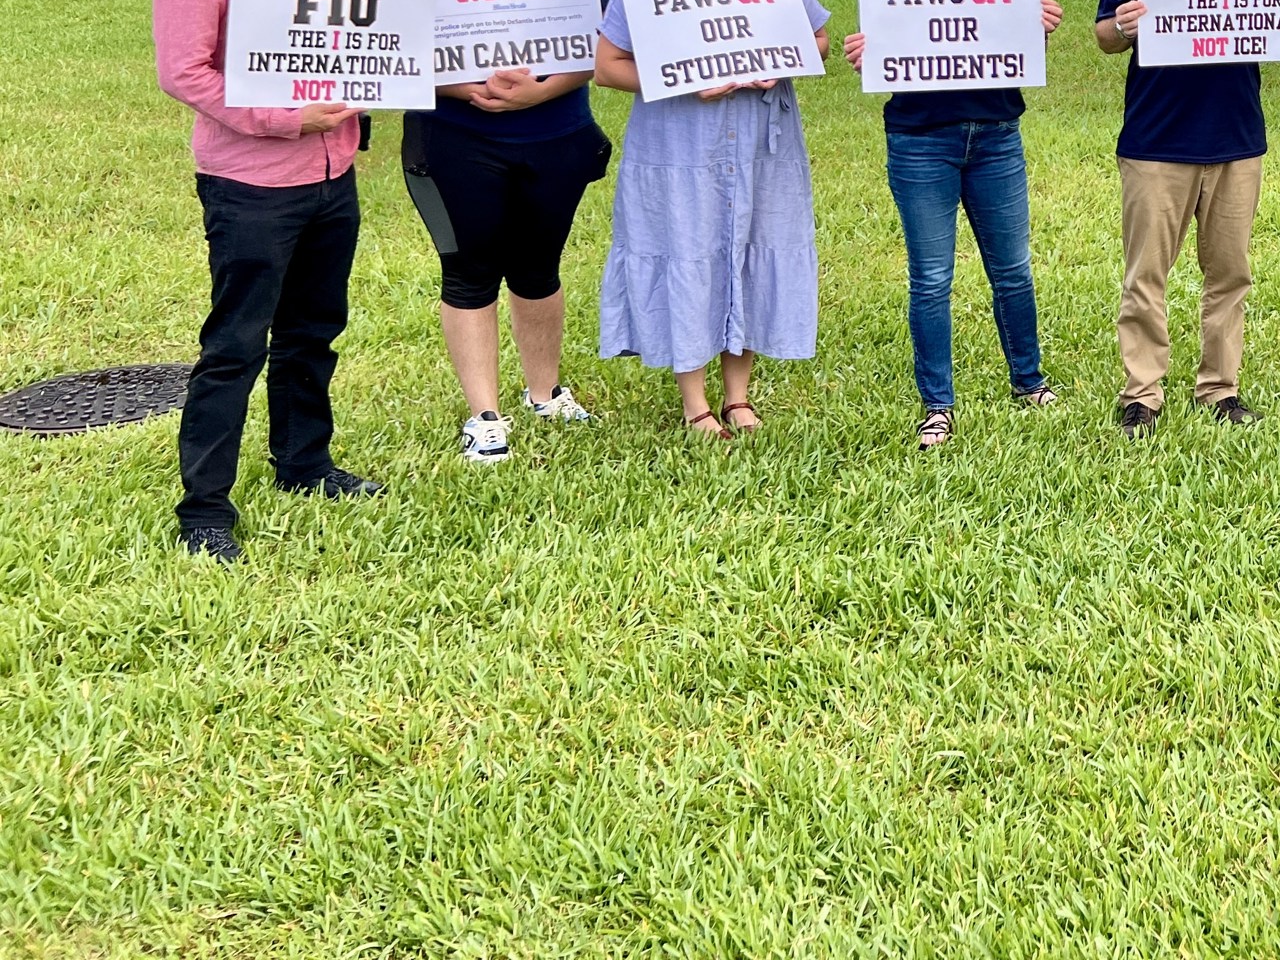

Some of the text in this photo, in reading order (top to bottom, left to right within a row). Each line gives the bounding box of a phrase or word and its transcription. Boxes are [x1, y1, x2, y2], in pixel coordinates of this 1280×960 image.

[288, 30, 401, 51] THE I IS FOR
[700, 15, 753, 43] OUR
[929, 17, 979, 43] OUR
[434, 33, 594, 73] ON CAMPUS!
[1192, 37, 1267, 57] NOT ICE!
[248, 52, 421, 76] INTERNATIONAL
[661, 45, 804, 88] STUDENTS!
[883, 53, 1024, 82] STUDENTS!
[292, 79, 382, 101] NOT ICE!
